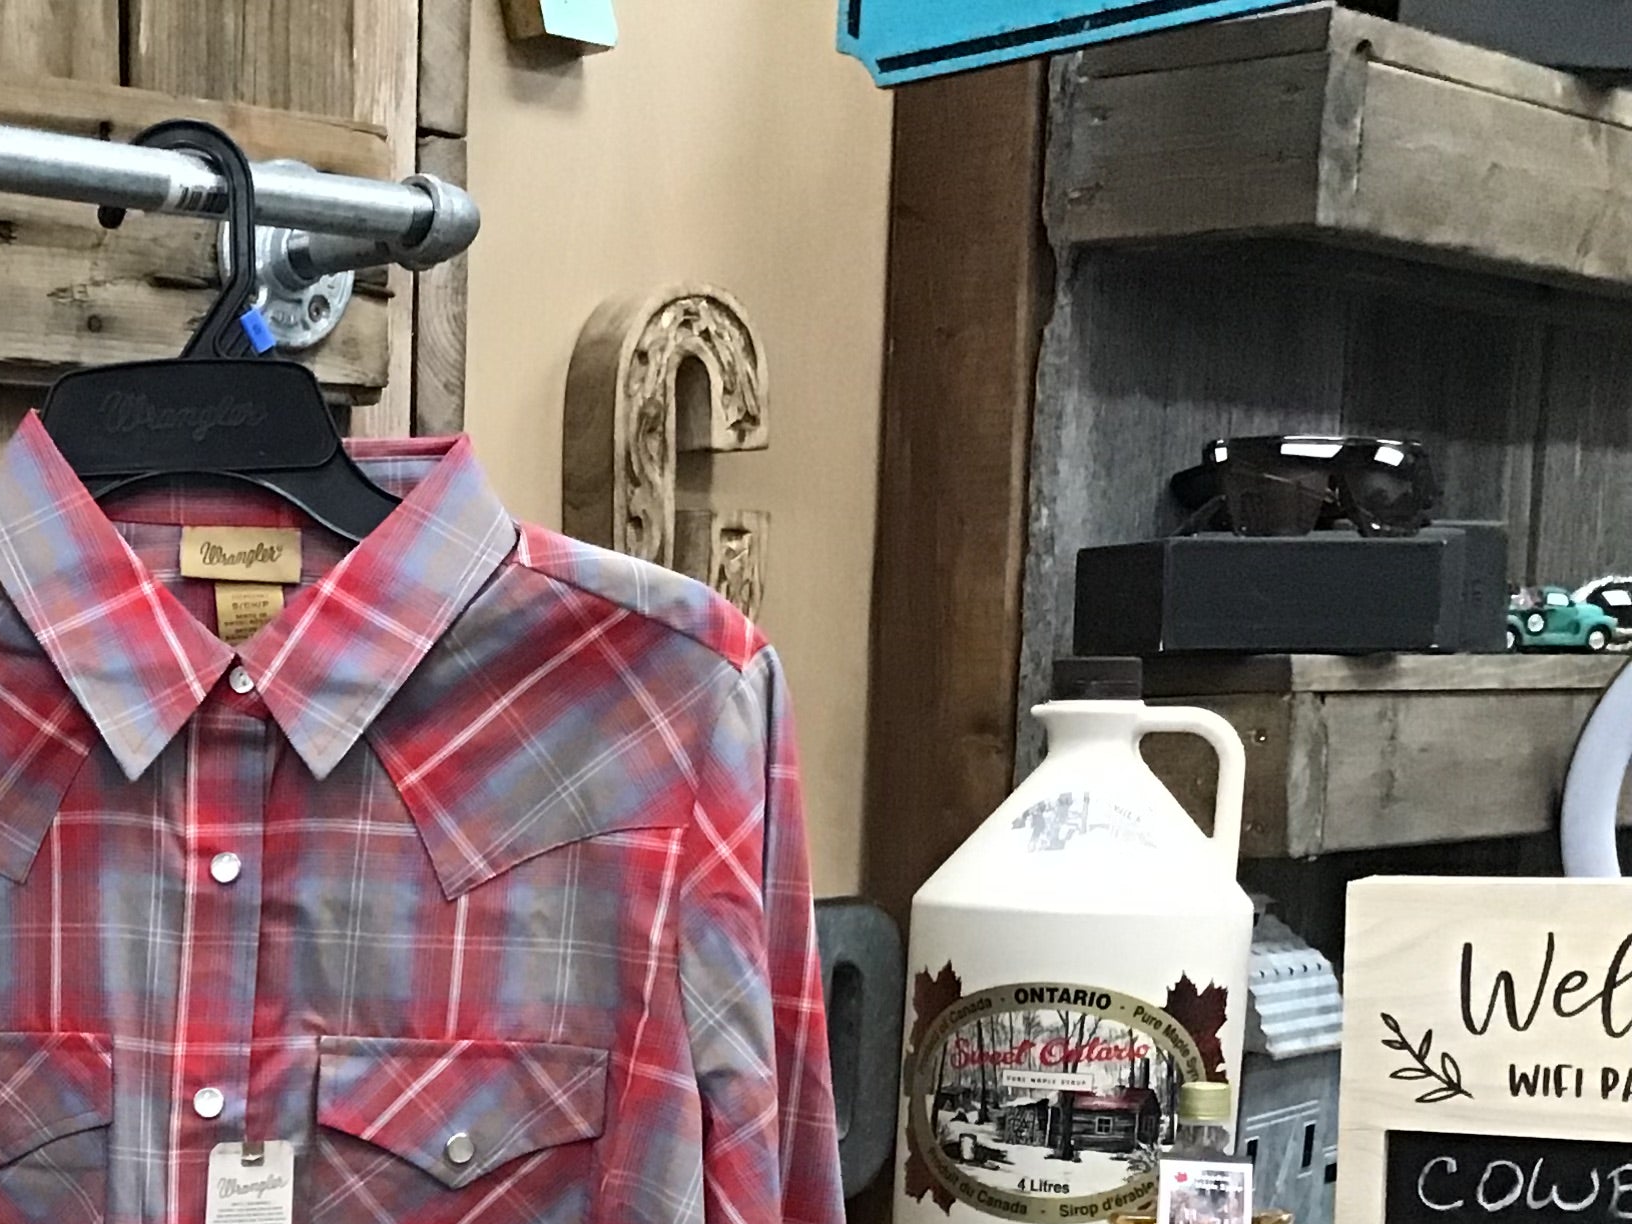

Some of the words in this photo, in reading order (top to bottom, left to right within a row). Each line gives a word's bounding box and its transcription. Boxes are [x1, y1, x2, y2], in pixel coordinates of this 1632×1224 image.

[99, 391, 268, 442] Wrangler
[200, 541, 282, 568] Wrangler
[949, 997, 992, 1023] Canada
[1014, 987, 1112, 1010] ONTARIO
[1132, 1005, 1164, 1030] Pure
[1162, 1024, 1190, 1058] Maple
[951, 1037, 1036, 1069] Sweet
[1040, 1036, 1151, 1066] Ontario
[1509, 1063, 1583, 1098] WIFI
[216, 1174, 289, 1199] Wrangler
[959, 1182, 975, 1197] du
[976, 1190, 1028, 1217] Canada
[1059, 1203, 1099, 1218] Sirop
[1101, 1180, 1156, 1212] d'érable
[1017, 1178, 1026, 1192] 4
[1030, 1178, 1071, 1194] Litres
